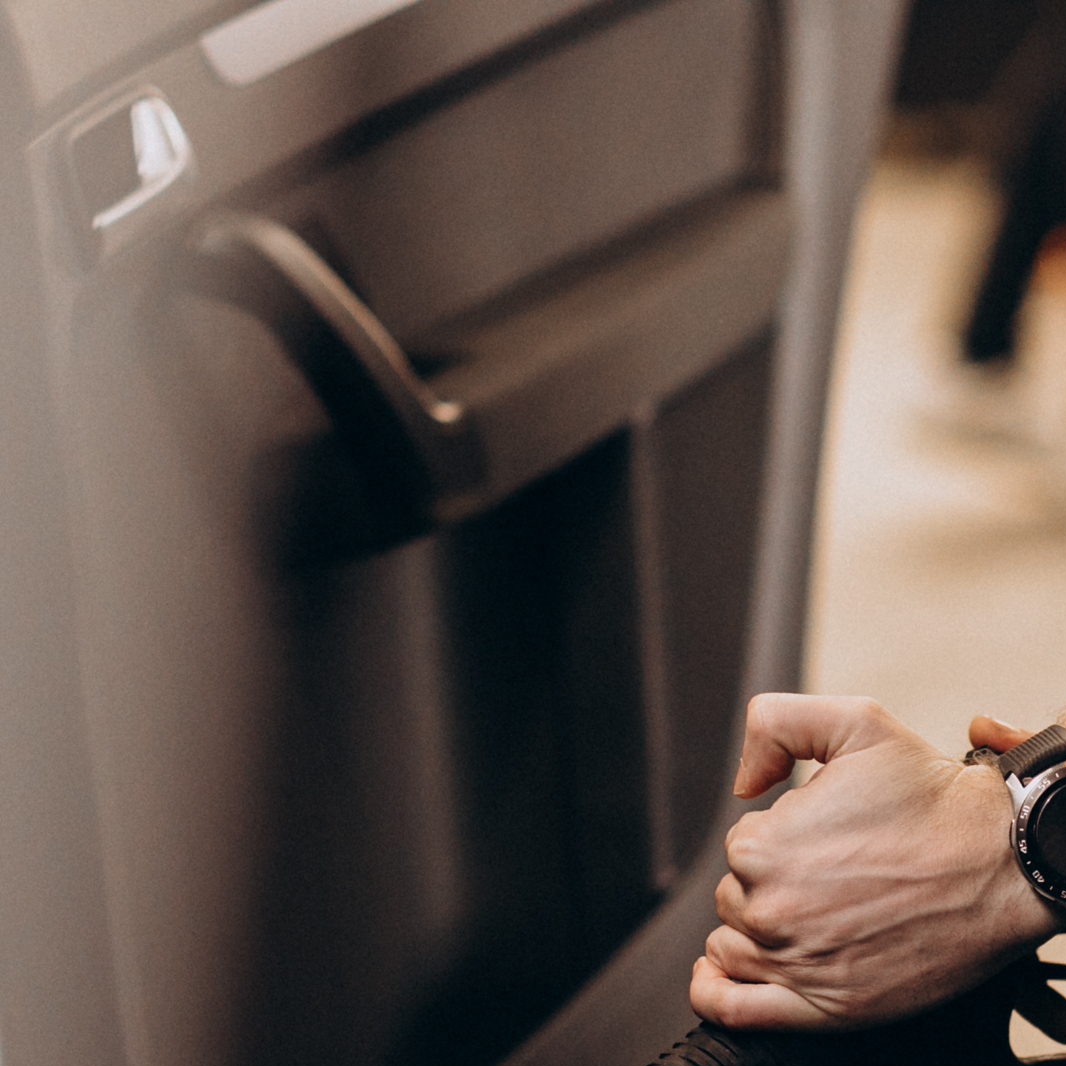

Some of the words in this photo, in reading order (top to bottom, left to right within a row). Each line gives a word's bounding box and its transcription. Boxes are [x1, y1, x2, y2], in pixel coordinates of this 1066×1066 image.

[1037, 778, 1051, 789] 55
[1020, 805, 1031, 820] 50
[1018, 839, 1028, 854] 45
[1031, 869, 1046, 883] 40
